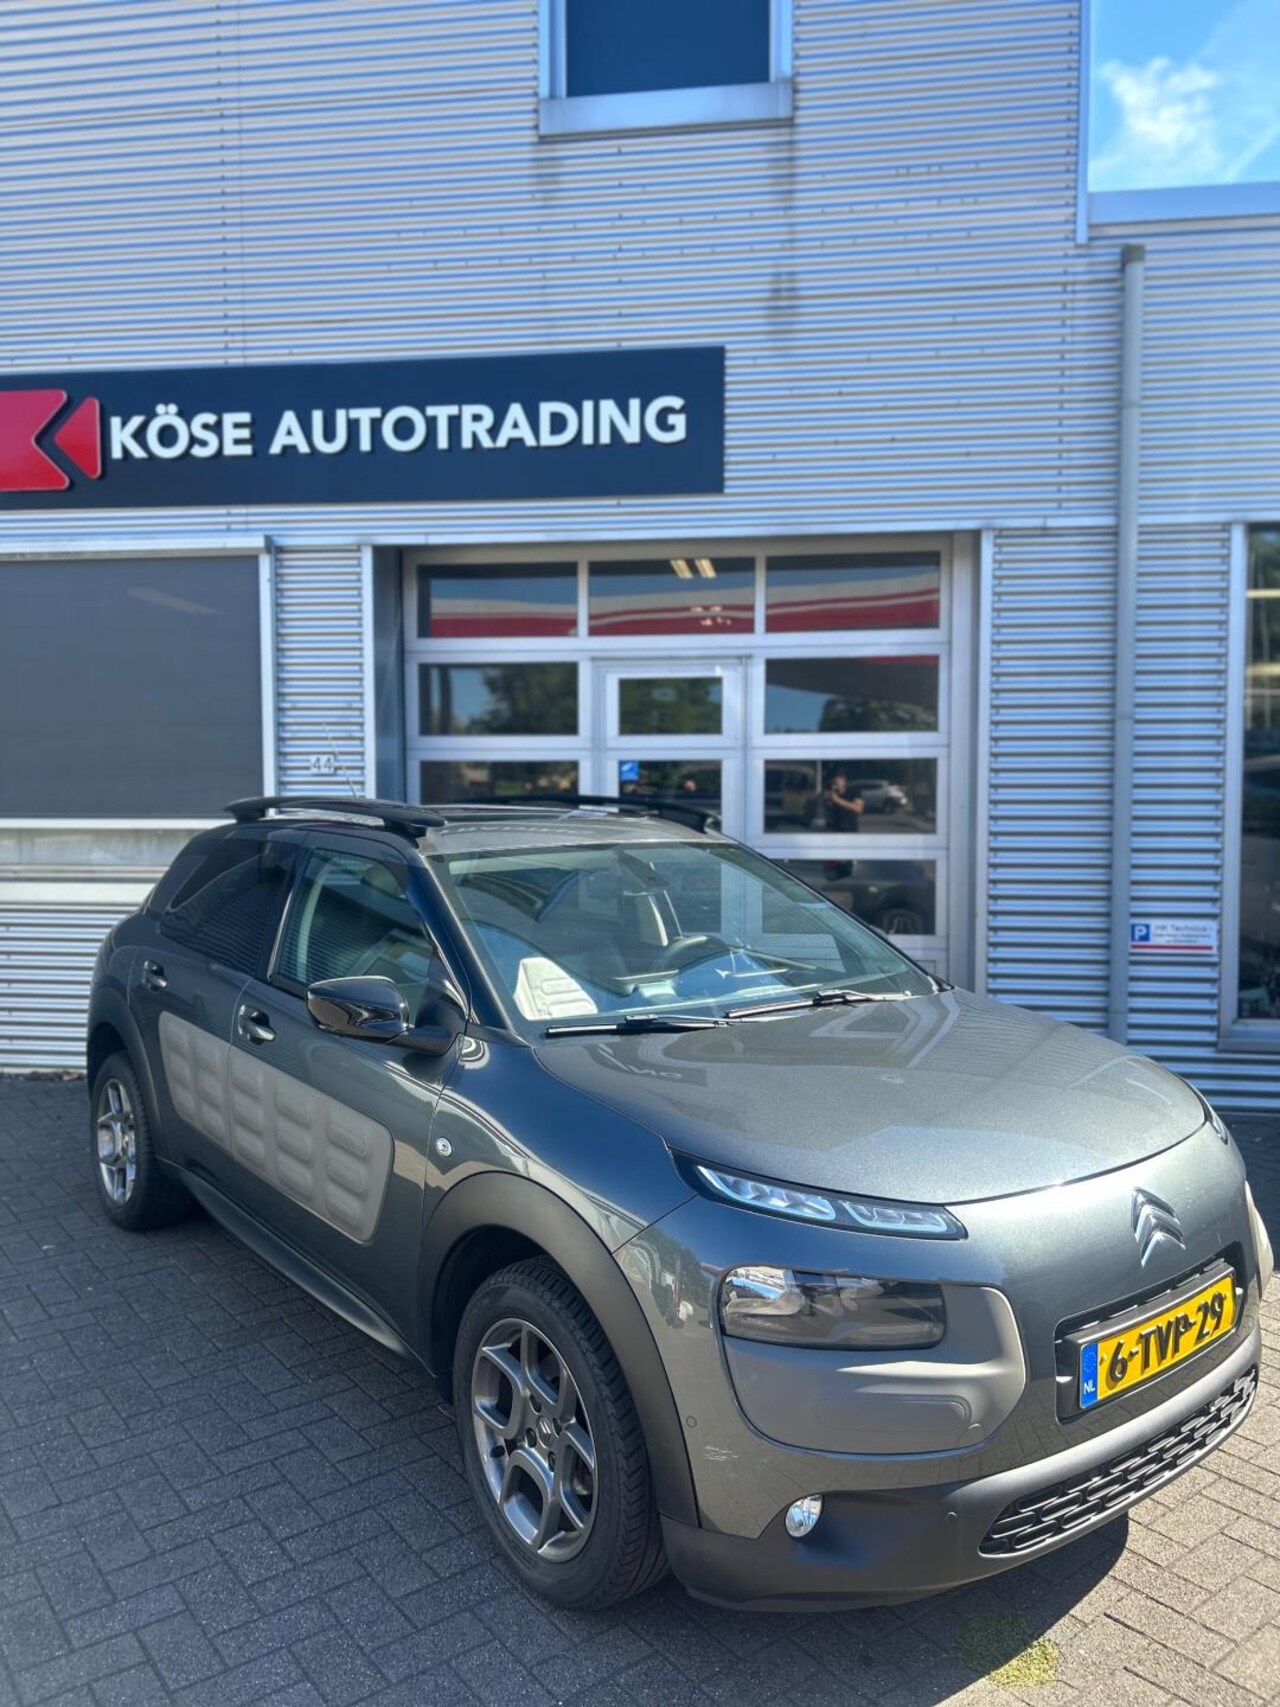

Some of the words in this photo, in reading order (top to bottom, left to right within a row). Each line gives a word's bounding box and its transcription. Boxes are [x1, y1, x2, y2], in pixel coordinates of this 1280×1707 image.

[110, 403, 253, 460] KÖSE
[269, 396, 687, 455] AUTOTRADING
[1107, 1291, 1226, 1383] 6-TVP-29
[1083, 1379, 1096, 1395] NL
